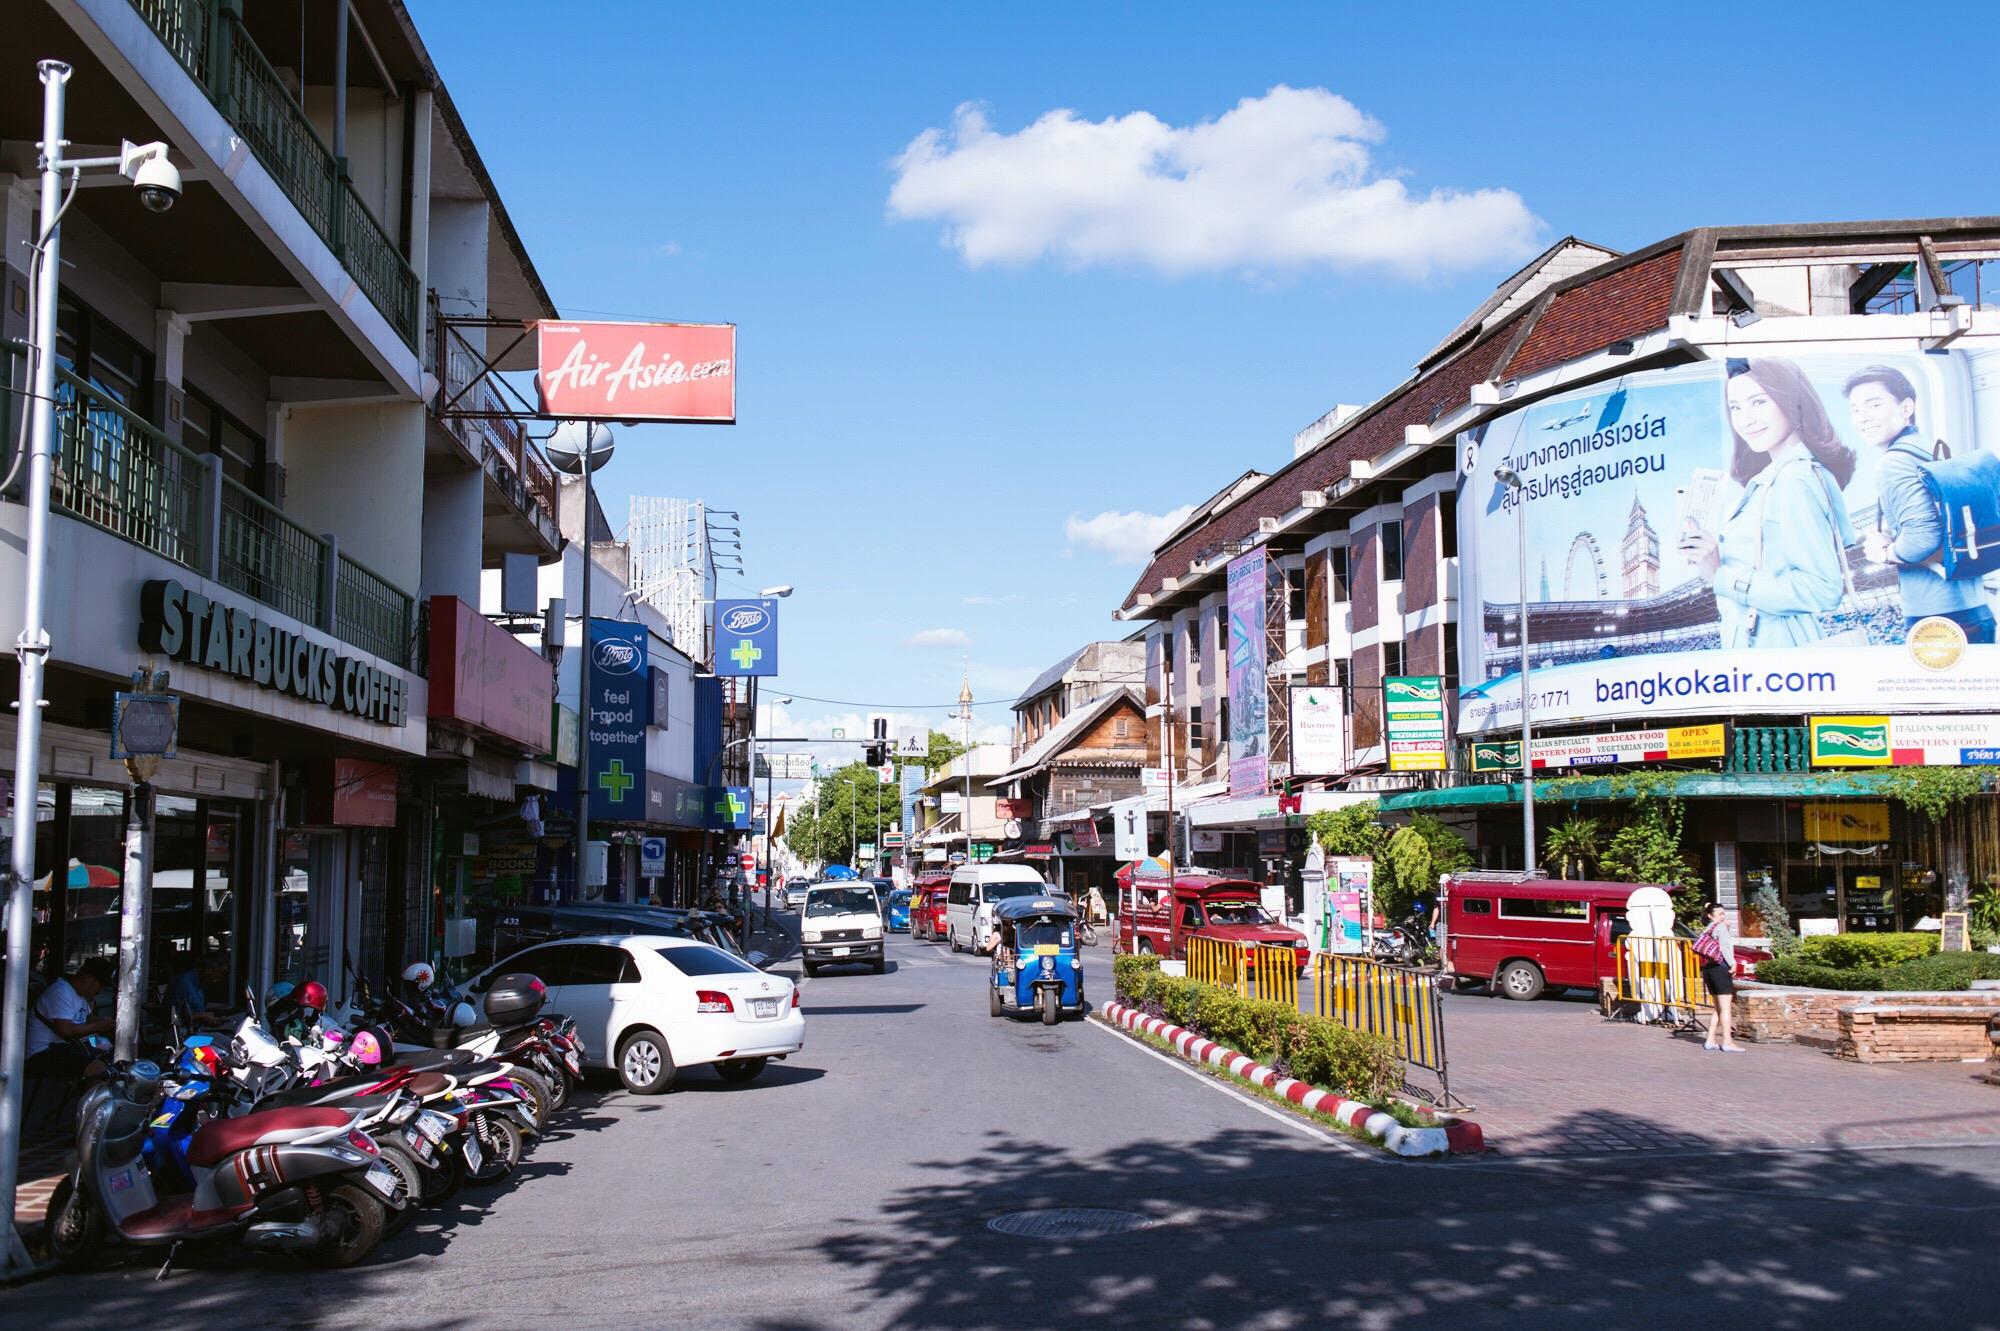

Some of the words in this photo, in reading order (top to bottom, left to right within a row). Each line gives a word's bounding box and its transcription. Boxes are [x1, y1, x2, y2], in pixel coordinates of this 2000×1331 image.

[727, 610, 763, 629] Boots
[158, 579, 336, 706] STARBUCKS
[342, 656, 409, 728] COFFEE
[598, 644, 634, 667] Boots
[1596, 667, 1836, 705] bangkokair.com
[604, 689, 630, 704] feel
[1541, 690, 1569, 708] 1771
[600, 709, 633, 726] good
[1681, 728, 1709, 737] OPEN
[1936, 723, 1989, 732] SPECIALTY
[1554, 737, 1591, 746] SPECIALTY
[1597, 734, 1636, 744] MEXICAN
[1640, 732, 1665, 740] FOOD
[1953, 738, 1987, 746] FOOD
[1597, 743, 1643, 752] VEGETARIAN
[1643, 742, 1665, 750] FOOD
[1573, 757, 1591, 765] THAI
[1592, 755, 1614, 763] FOOD
[488, 859, 537, 869] BOOKS
[503, 917, 520, 926] 432
